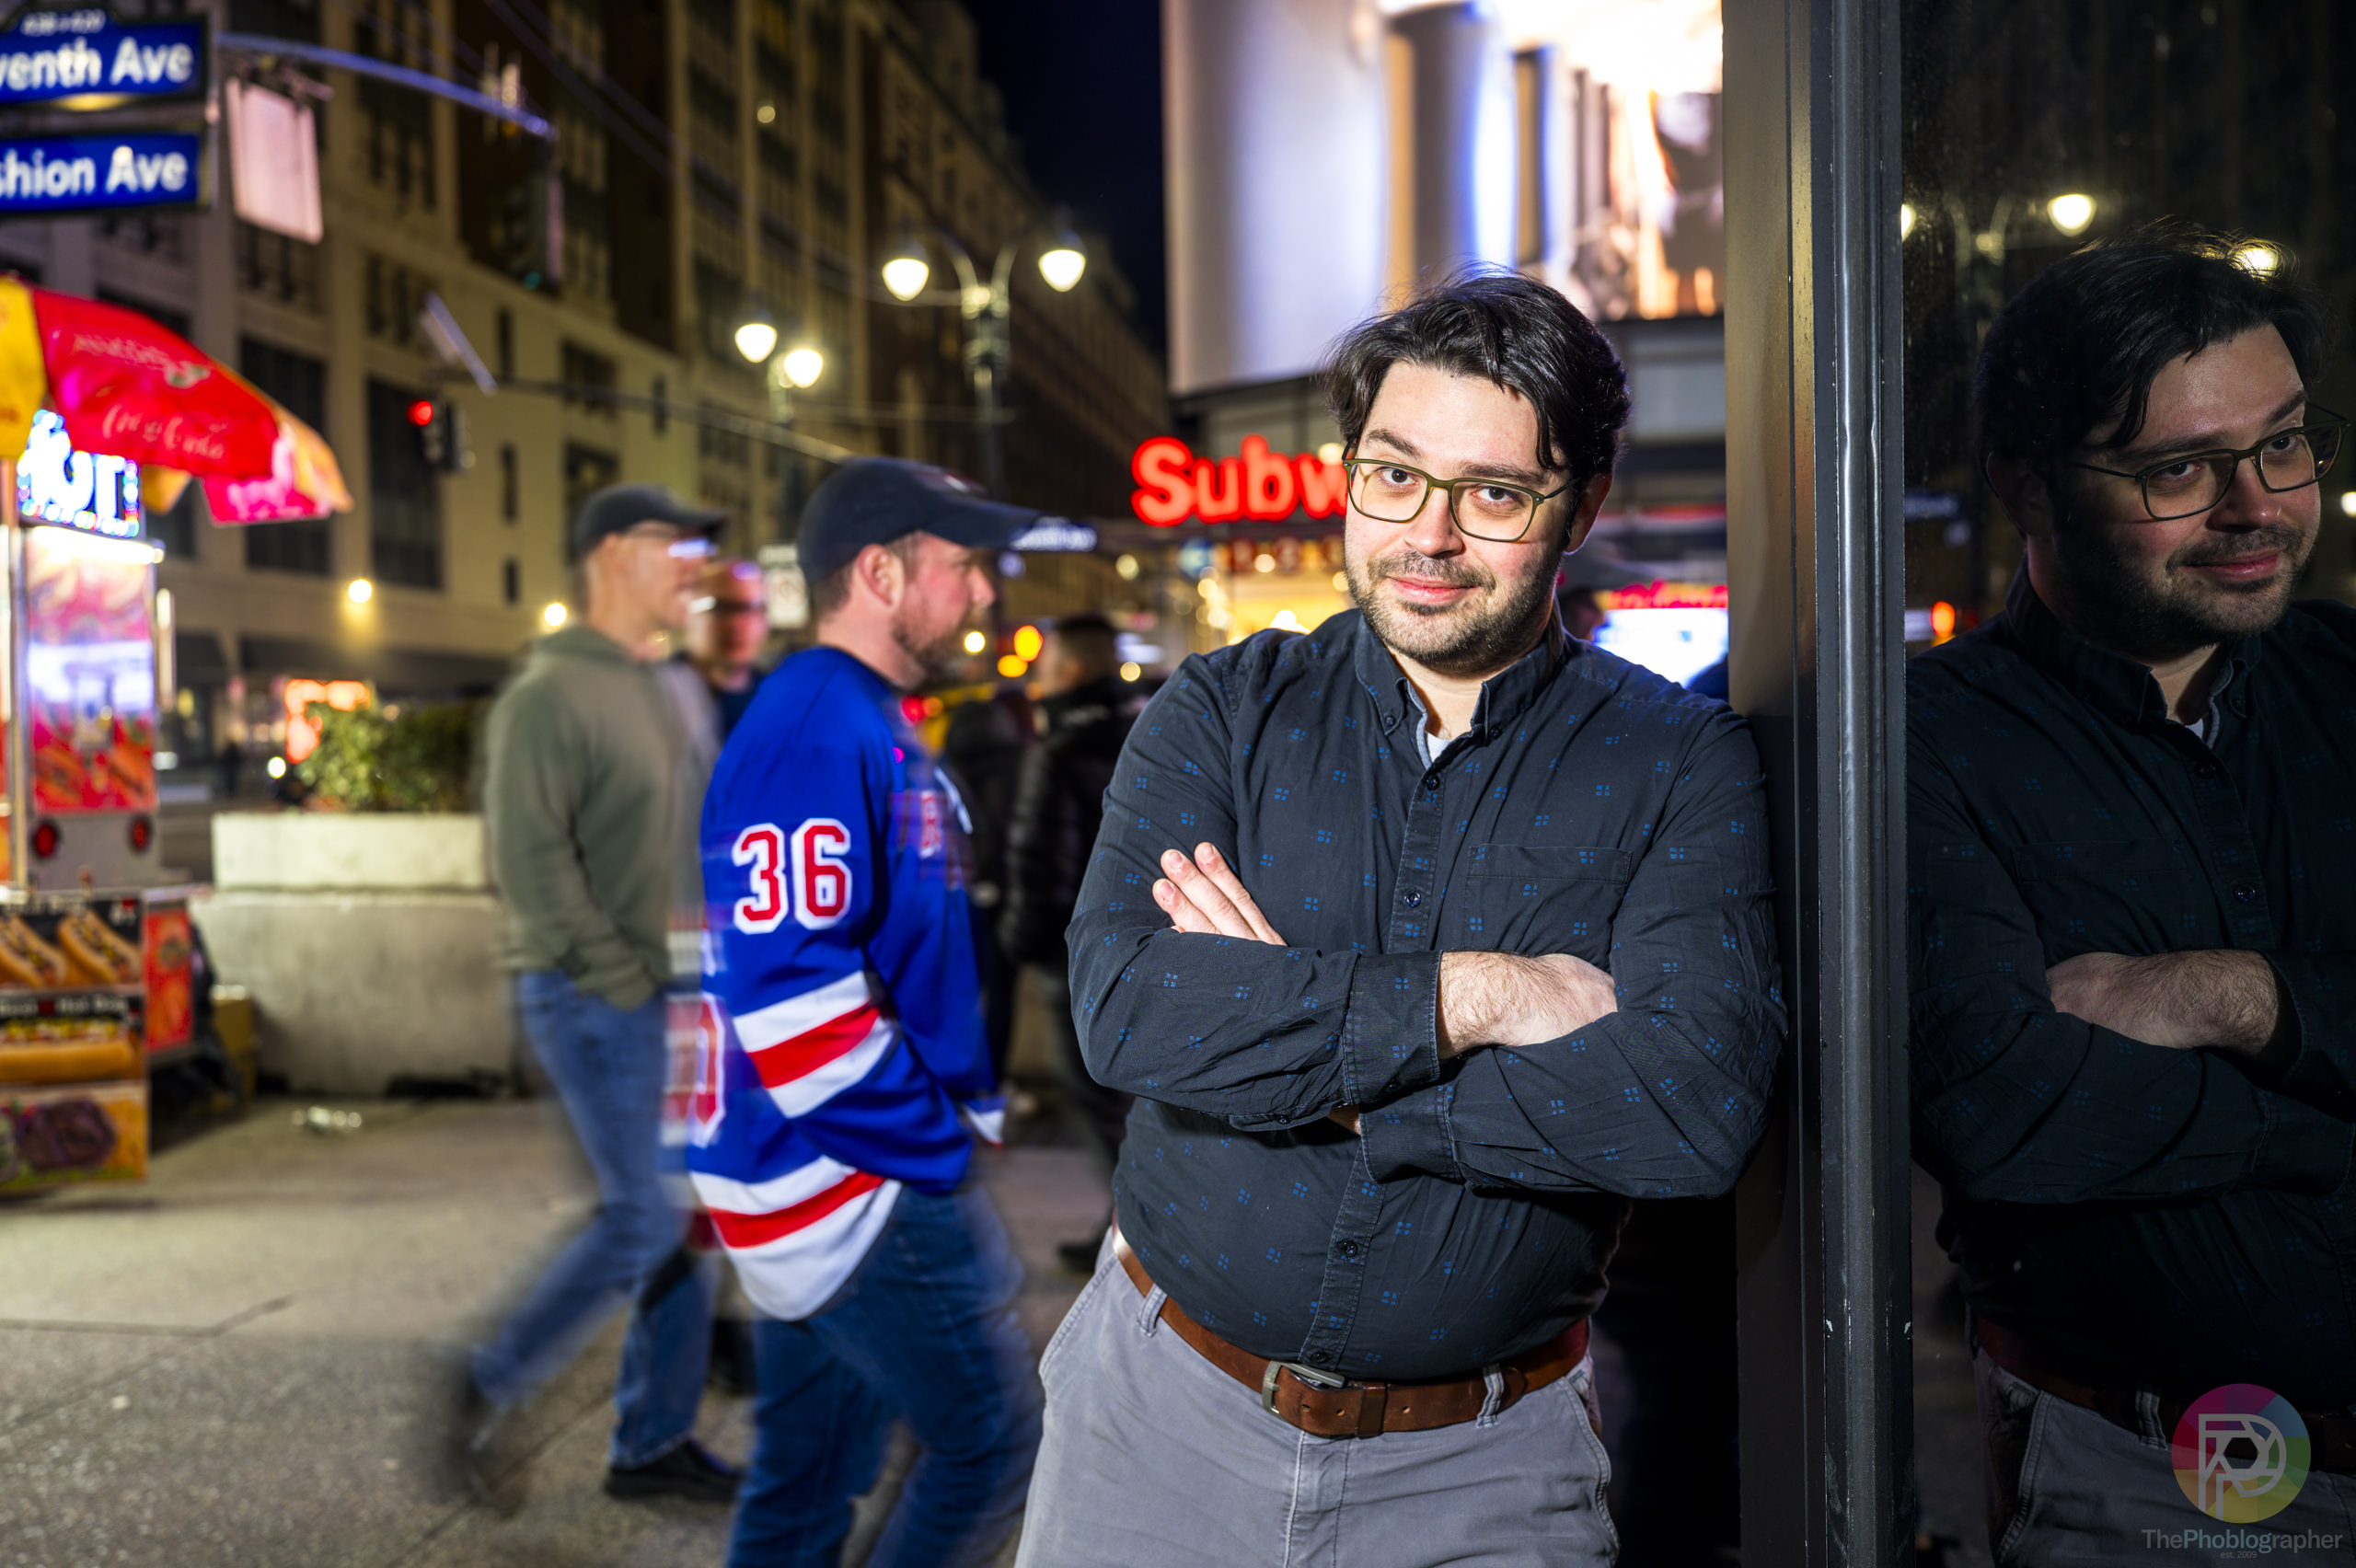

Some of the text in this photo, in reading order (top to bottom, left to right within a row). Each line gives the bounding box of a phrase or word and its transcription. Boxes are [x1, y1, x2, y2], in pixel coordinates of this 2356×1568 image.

[110, 37, 193, 86] Ave
[106, 145, 188, 194] Ave
[732, 818, 851, 935] 36
